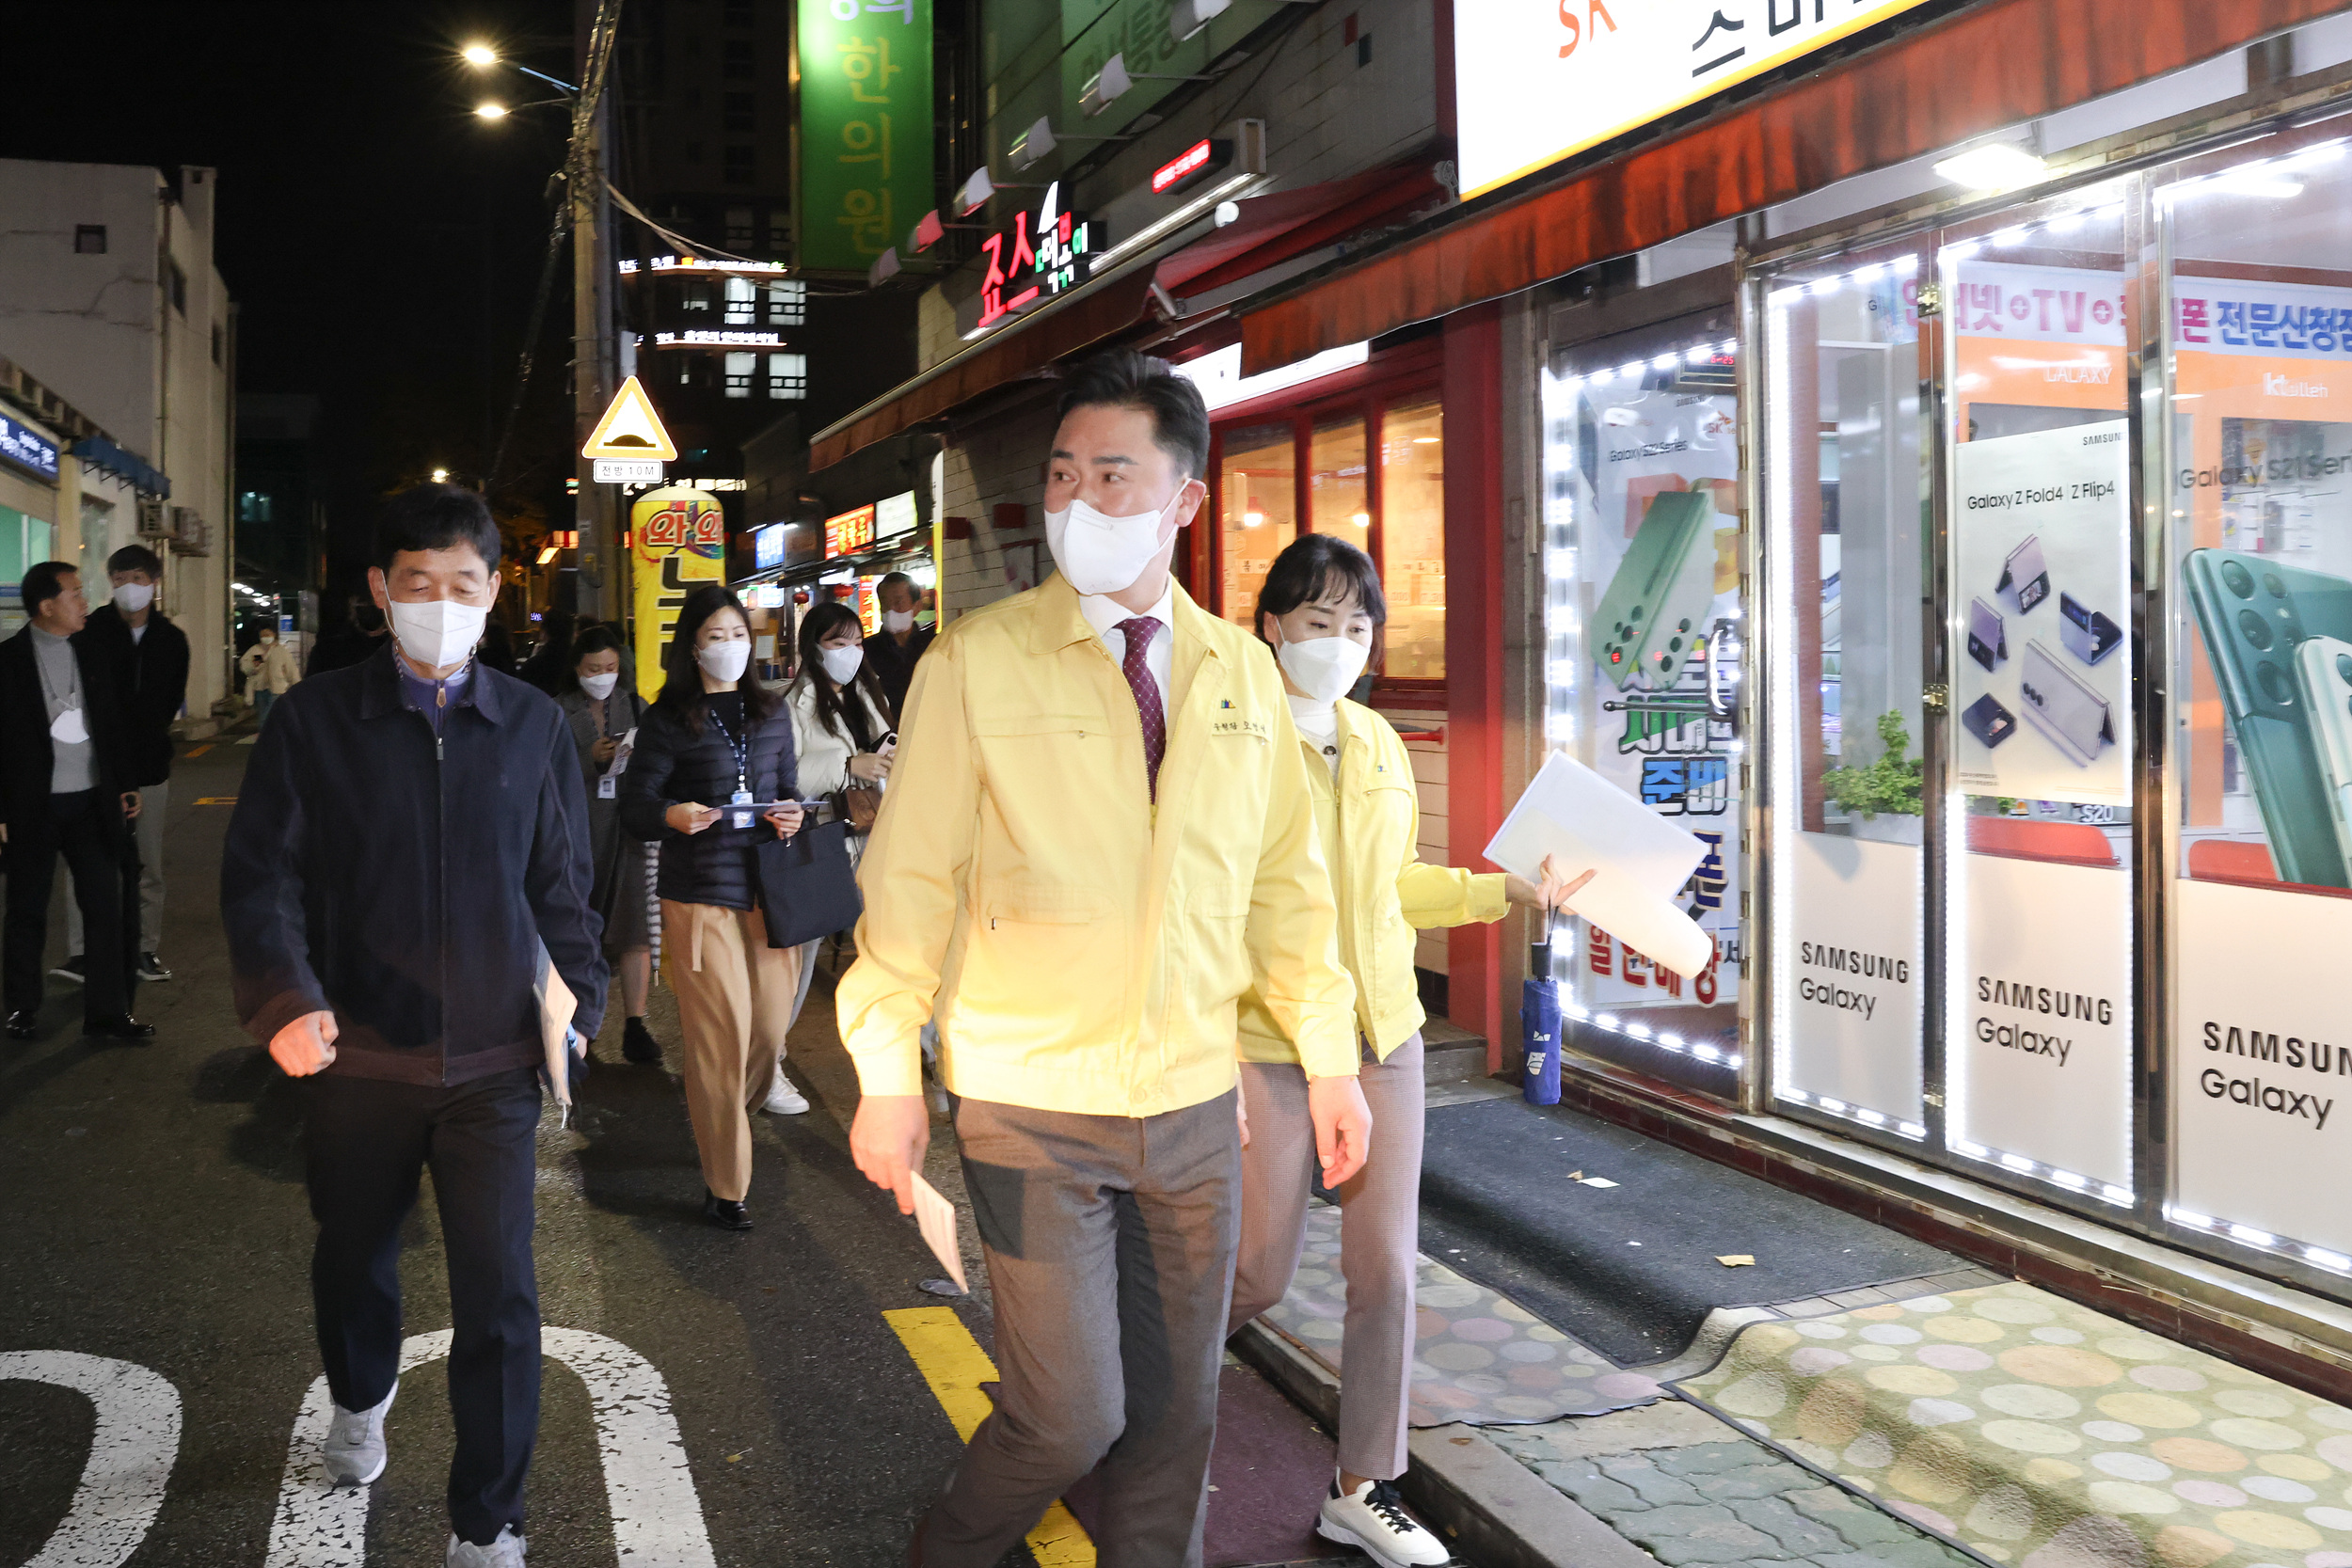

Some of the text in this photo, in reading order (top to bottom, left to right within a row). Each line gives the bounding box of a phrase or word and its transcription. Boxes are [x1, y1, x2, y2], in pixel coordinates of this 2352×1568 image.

[835, 36, 900, 257] 한의원
[2083, 432, 2126, 446] SAMSUN
[601, 465, 654, 477] 전방 10M
[2180, 464, 2263, 488] Galaxy
[2308, 448, 2352, 479] Ser
[1967, 480, 2116, 510] Galaxy Z Fold4 Z Flip4
[2080, 805, 2115, 823] S20
[1801, 942, 1910, 983] SAMSUNG
[1799, 978, 1877, 1021] Galaxy
[1978, 976, 2113, 1026] SAMSUNG
[1976, 1018, 2072, 1067] Galaxy
[2201, 1069, 2334, 1131] Galaxy
